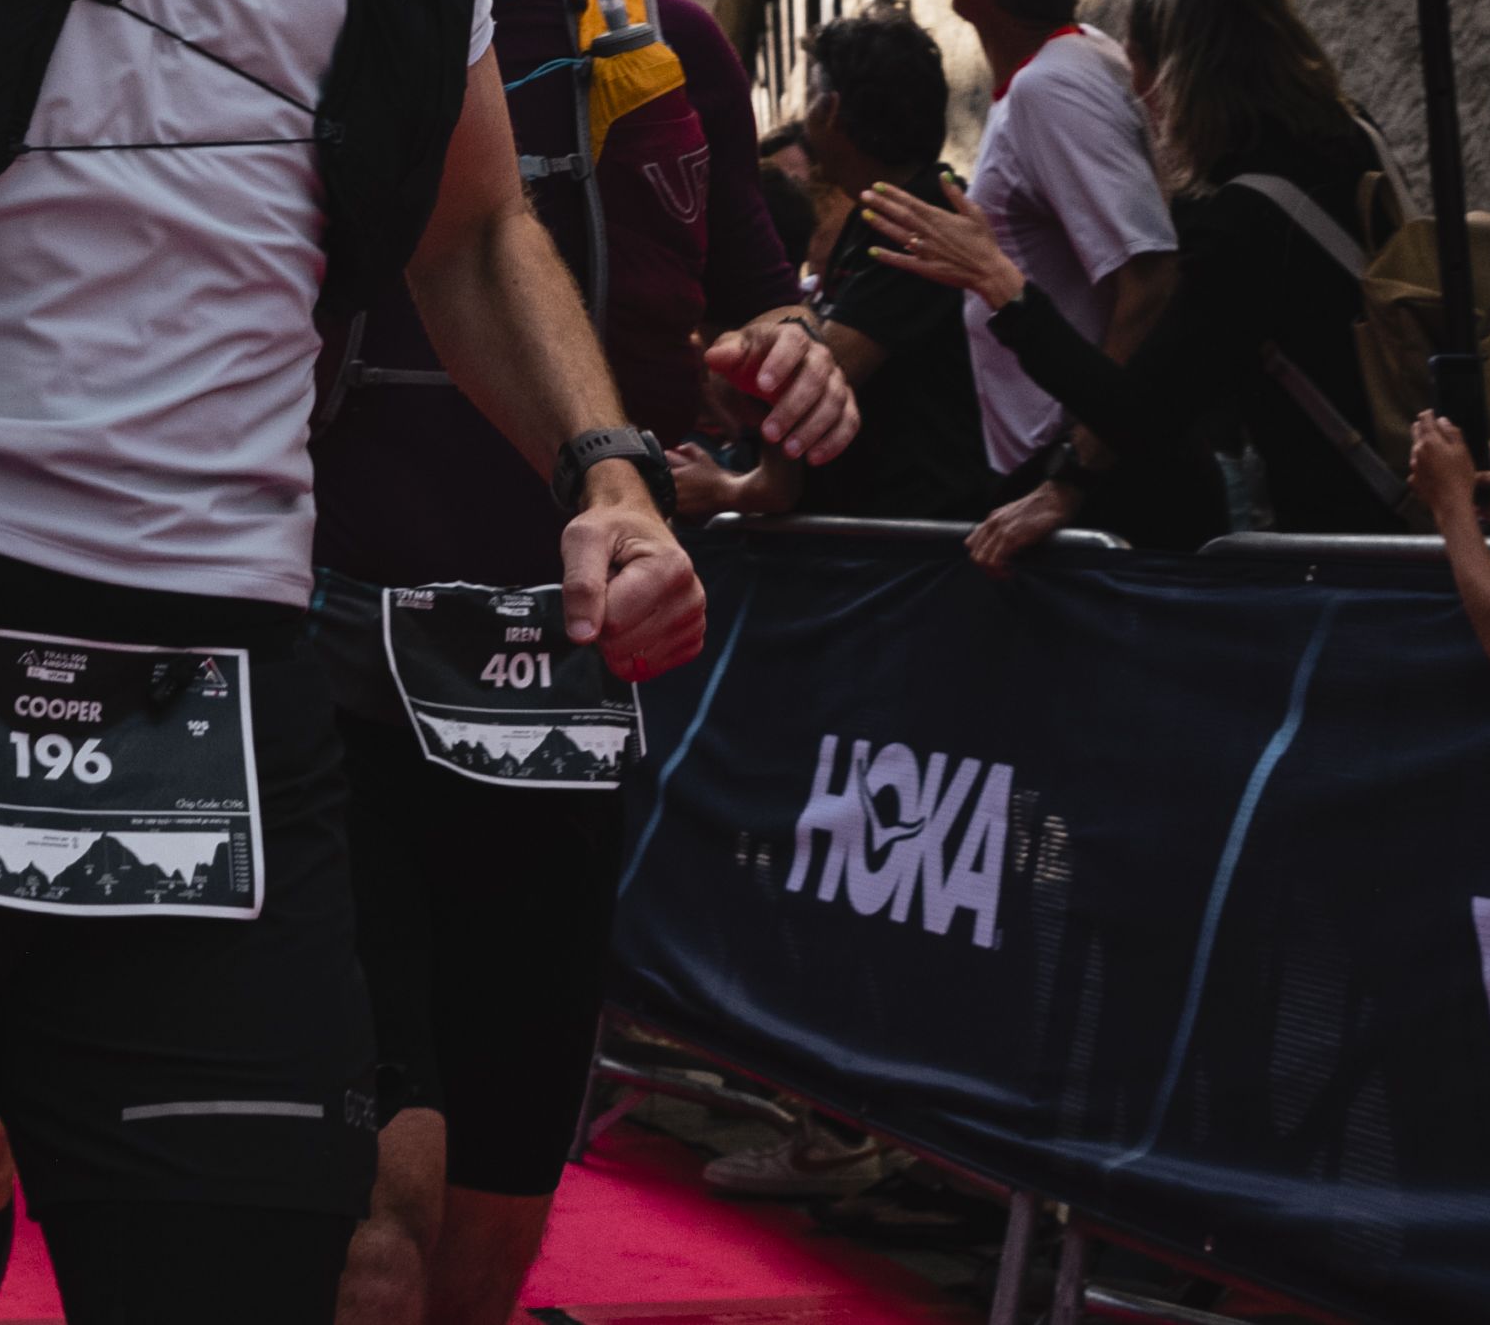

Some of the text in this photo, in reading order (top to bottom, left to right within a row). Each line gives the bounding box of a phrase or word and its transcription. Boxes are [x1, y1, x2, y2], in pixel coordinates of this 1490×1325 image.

[480, 652, 552, 690] 401
[14, 695, 103, 724] COOPER
[9, 730, 113, 784] 196
[785, 734, 1014, 950] HOKA
